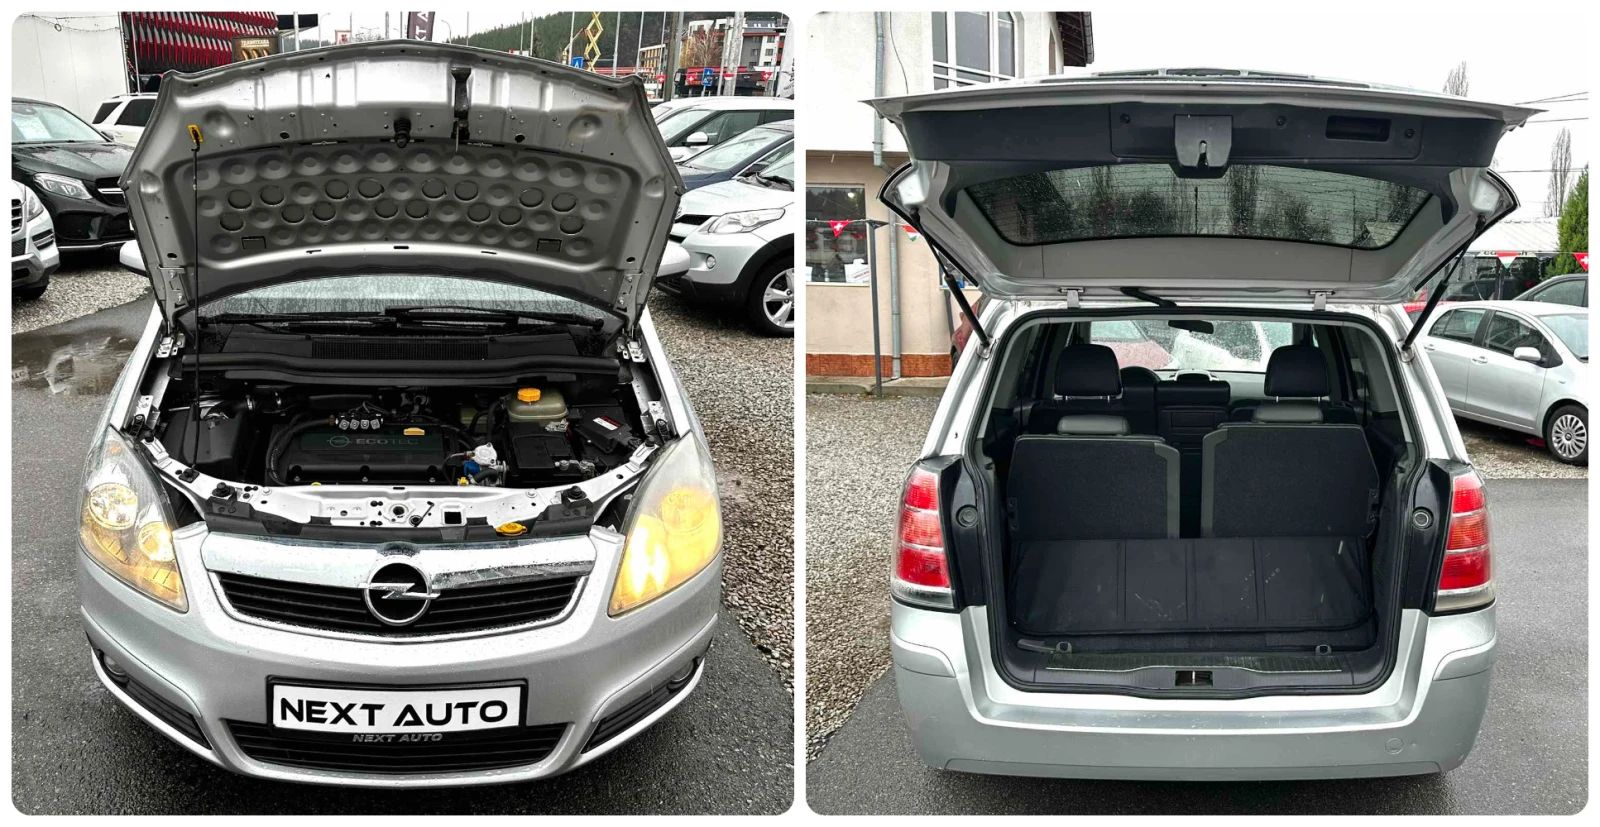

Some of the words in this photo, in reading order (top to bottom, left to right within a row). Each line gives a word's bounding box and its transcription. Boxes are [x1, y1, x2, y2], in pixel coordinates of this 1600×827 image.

[281, 697, 386, 727] NEXT
[393, 700, 508, 727] AUTO
[352, 733, 396, 743] NEXT
[399, 733, 443, 742] AUTO
